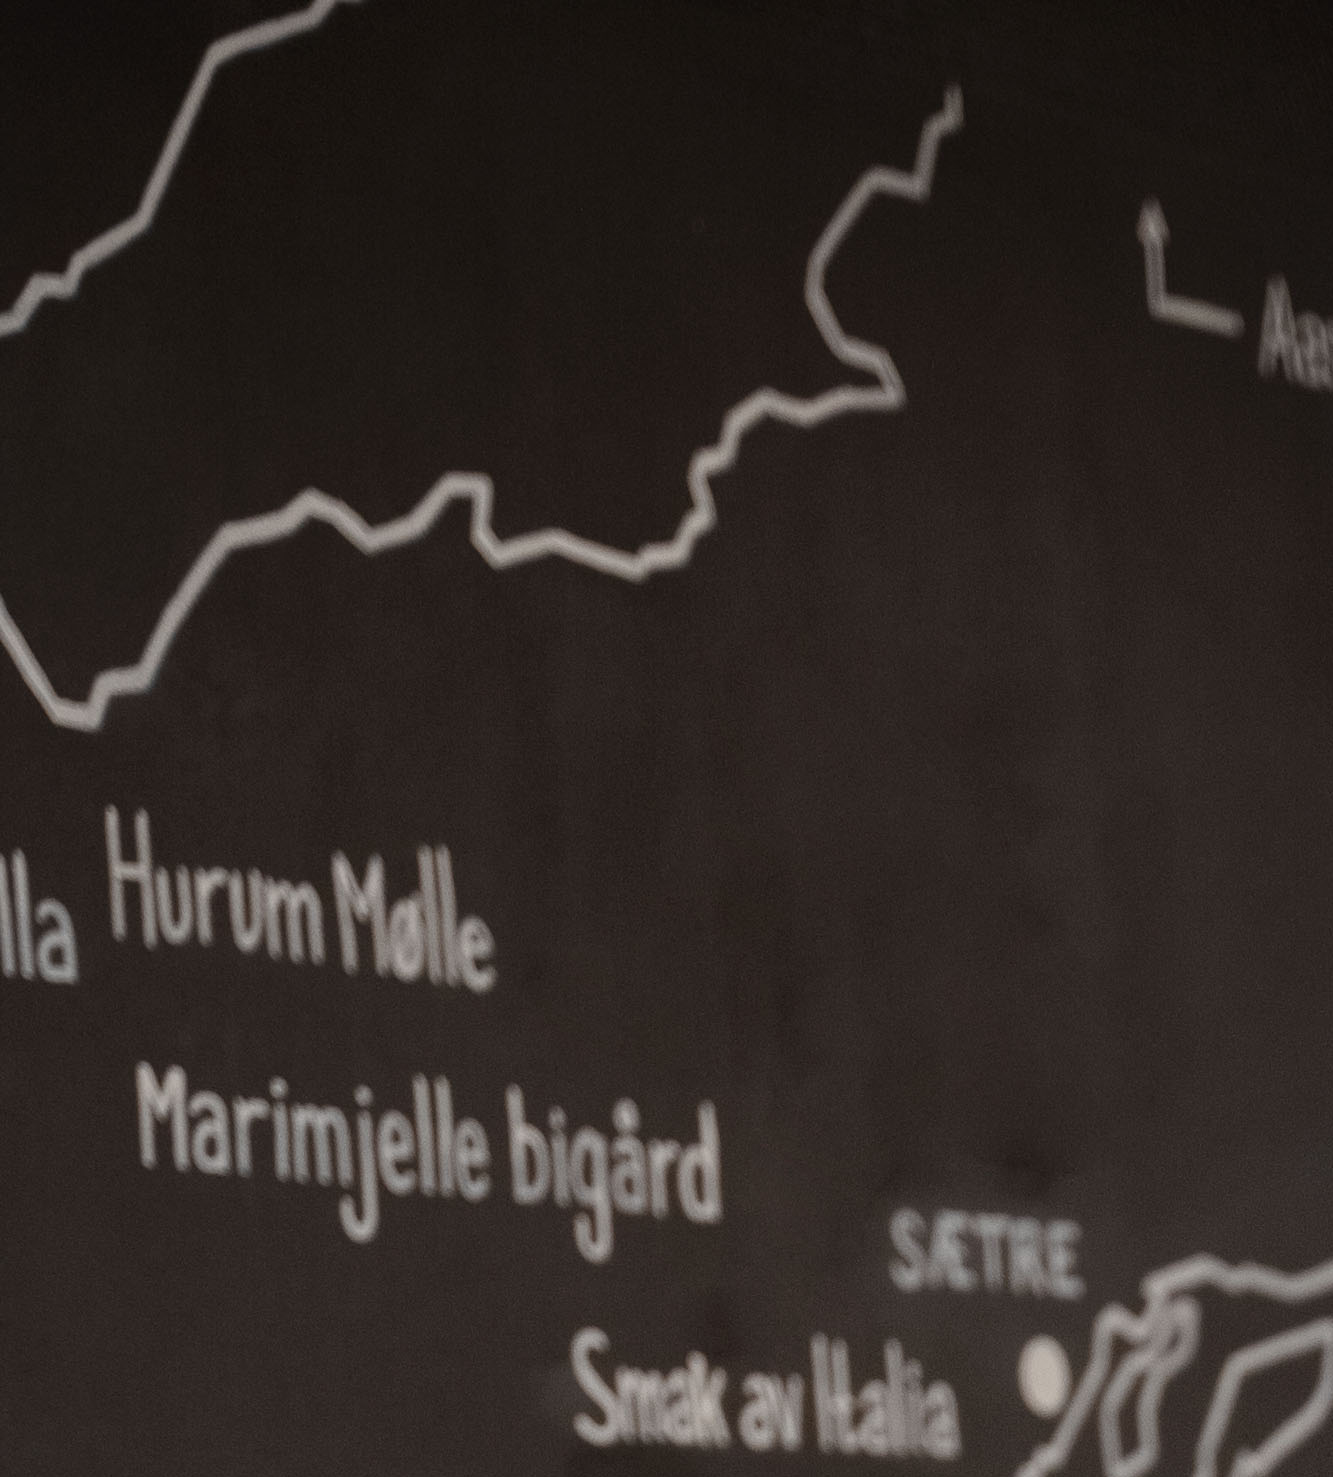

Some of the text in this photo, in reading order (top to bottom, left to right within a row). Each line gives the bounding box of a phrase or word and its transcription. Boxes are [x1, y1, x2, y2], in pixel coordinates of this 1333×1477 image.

[103, 803, 497, 994] Hurum Mølle
[134, 1060, 724, 1265] Marimjelle bigård
[888, 1207, 1086, 1301] SÆTRE
[569, 1326, 963, 1461] Smak av Italia
